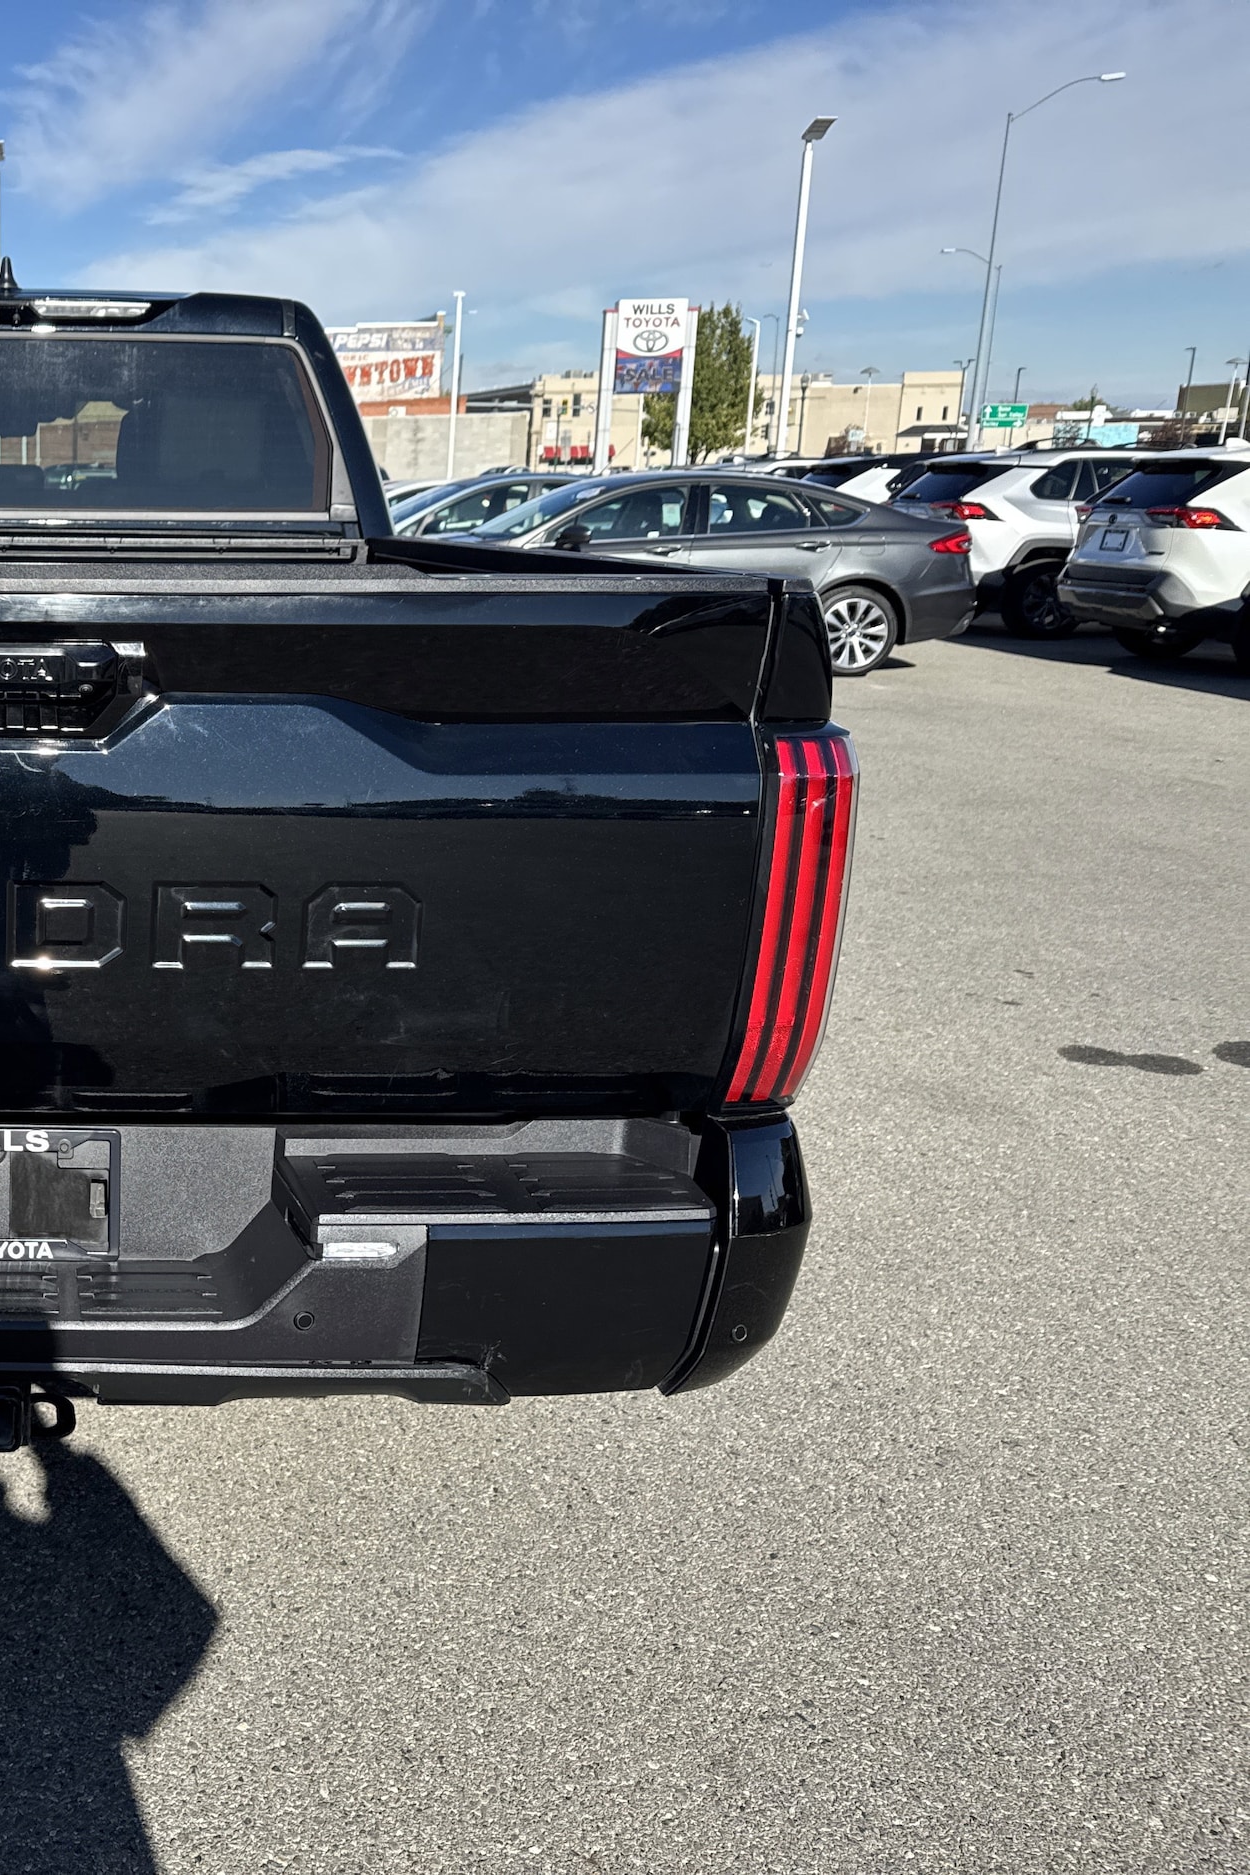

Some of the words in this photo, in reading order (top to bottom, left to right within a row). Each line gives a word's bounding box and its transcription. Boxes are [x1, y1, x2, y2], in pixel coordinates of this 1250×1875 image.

[632, 303, 675, 315] WILLS
[624, 316, 680, 328] TOYOTA
[333, 332, 389, 350] PEPSI
[624, 367, 673, 382] SALE
